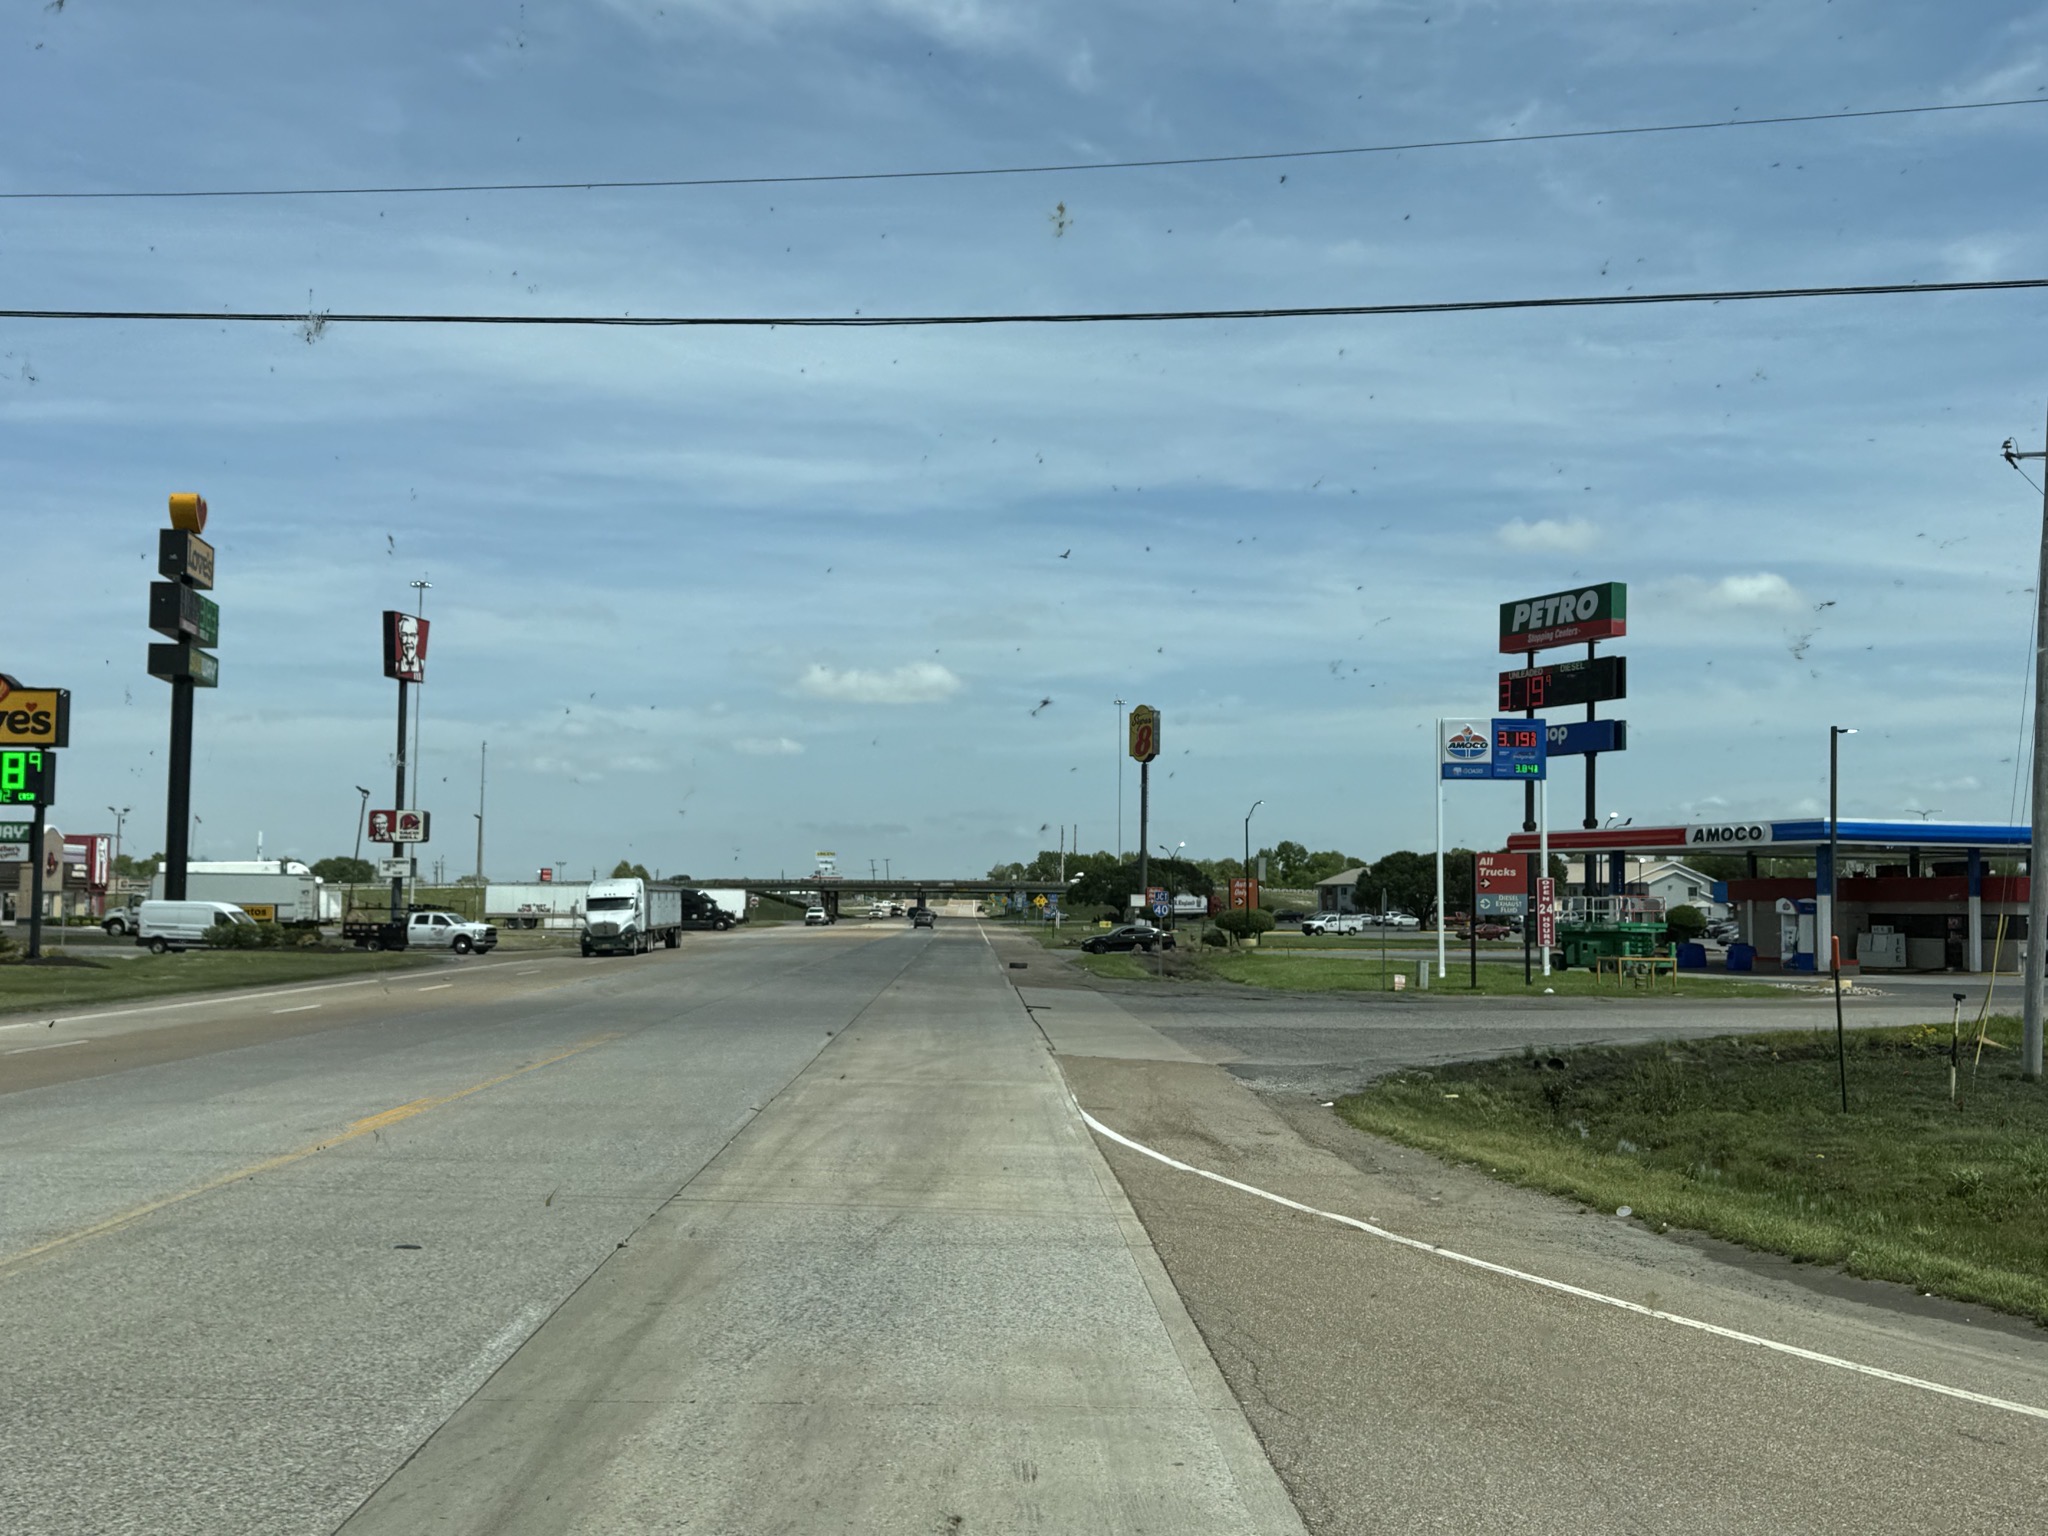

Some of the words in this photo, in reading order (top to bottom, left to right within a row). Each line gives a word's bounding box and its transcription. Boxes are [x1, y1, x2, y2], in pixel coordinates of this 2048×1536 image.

[1512, 590, 1599, 632] PETRO
[1528, 632, 1554, 643] Stopping
[1555, 627, 1579, 639] Centers
[1509, 668, 1544, 680] UNLEADED
[1560, 663, 1585, 673] DIESEL
[1134, 725, 1152, 757] 8
[0, 825, 26, 839] AY
[1692, 825, 1763, 842] AMOCO
[1479, 857, 1494, 866] All
[1479, 868, 1517, 876] Trucks
[1156, 892, 1168, 901] JCT
[1541, 880, 1550, 902] OPEN
[1154, 905, 1169, 915] 40
[1539, 904, 1553, 914] 24
[1542, 917, 1551, 945] HOURS
